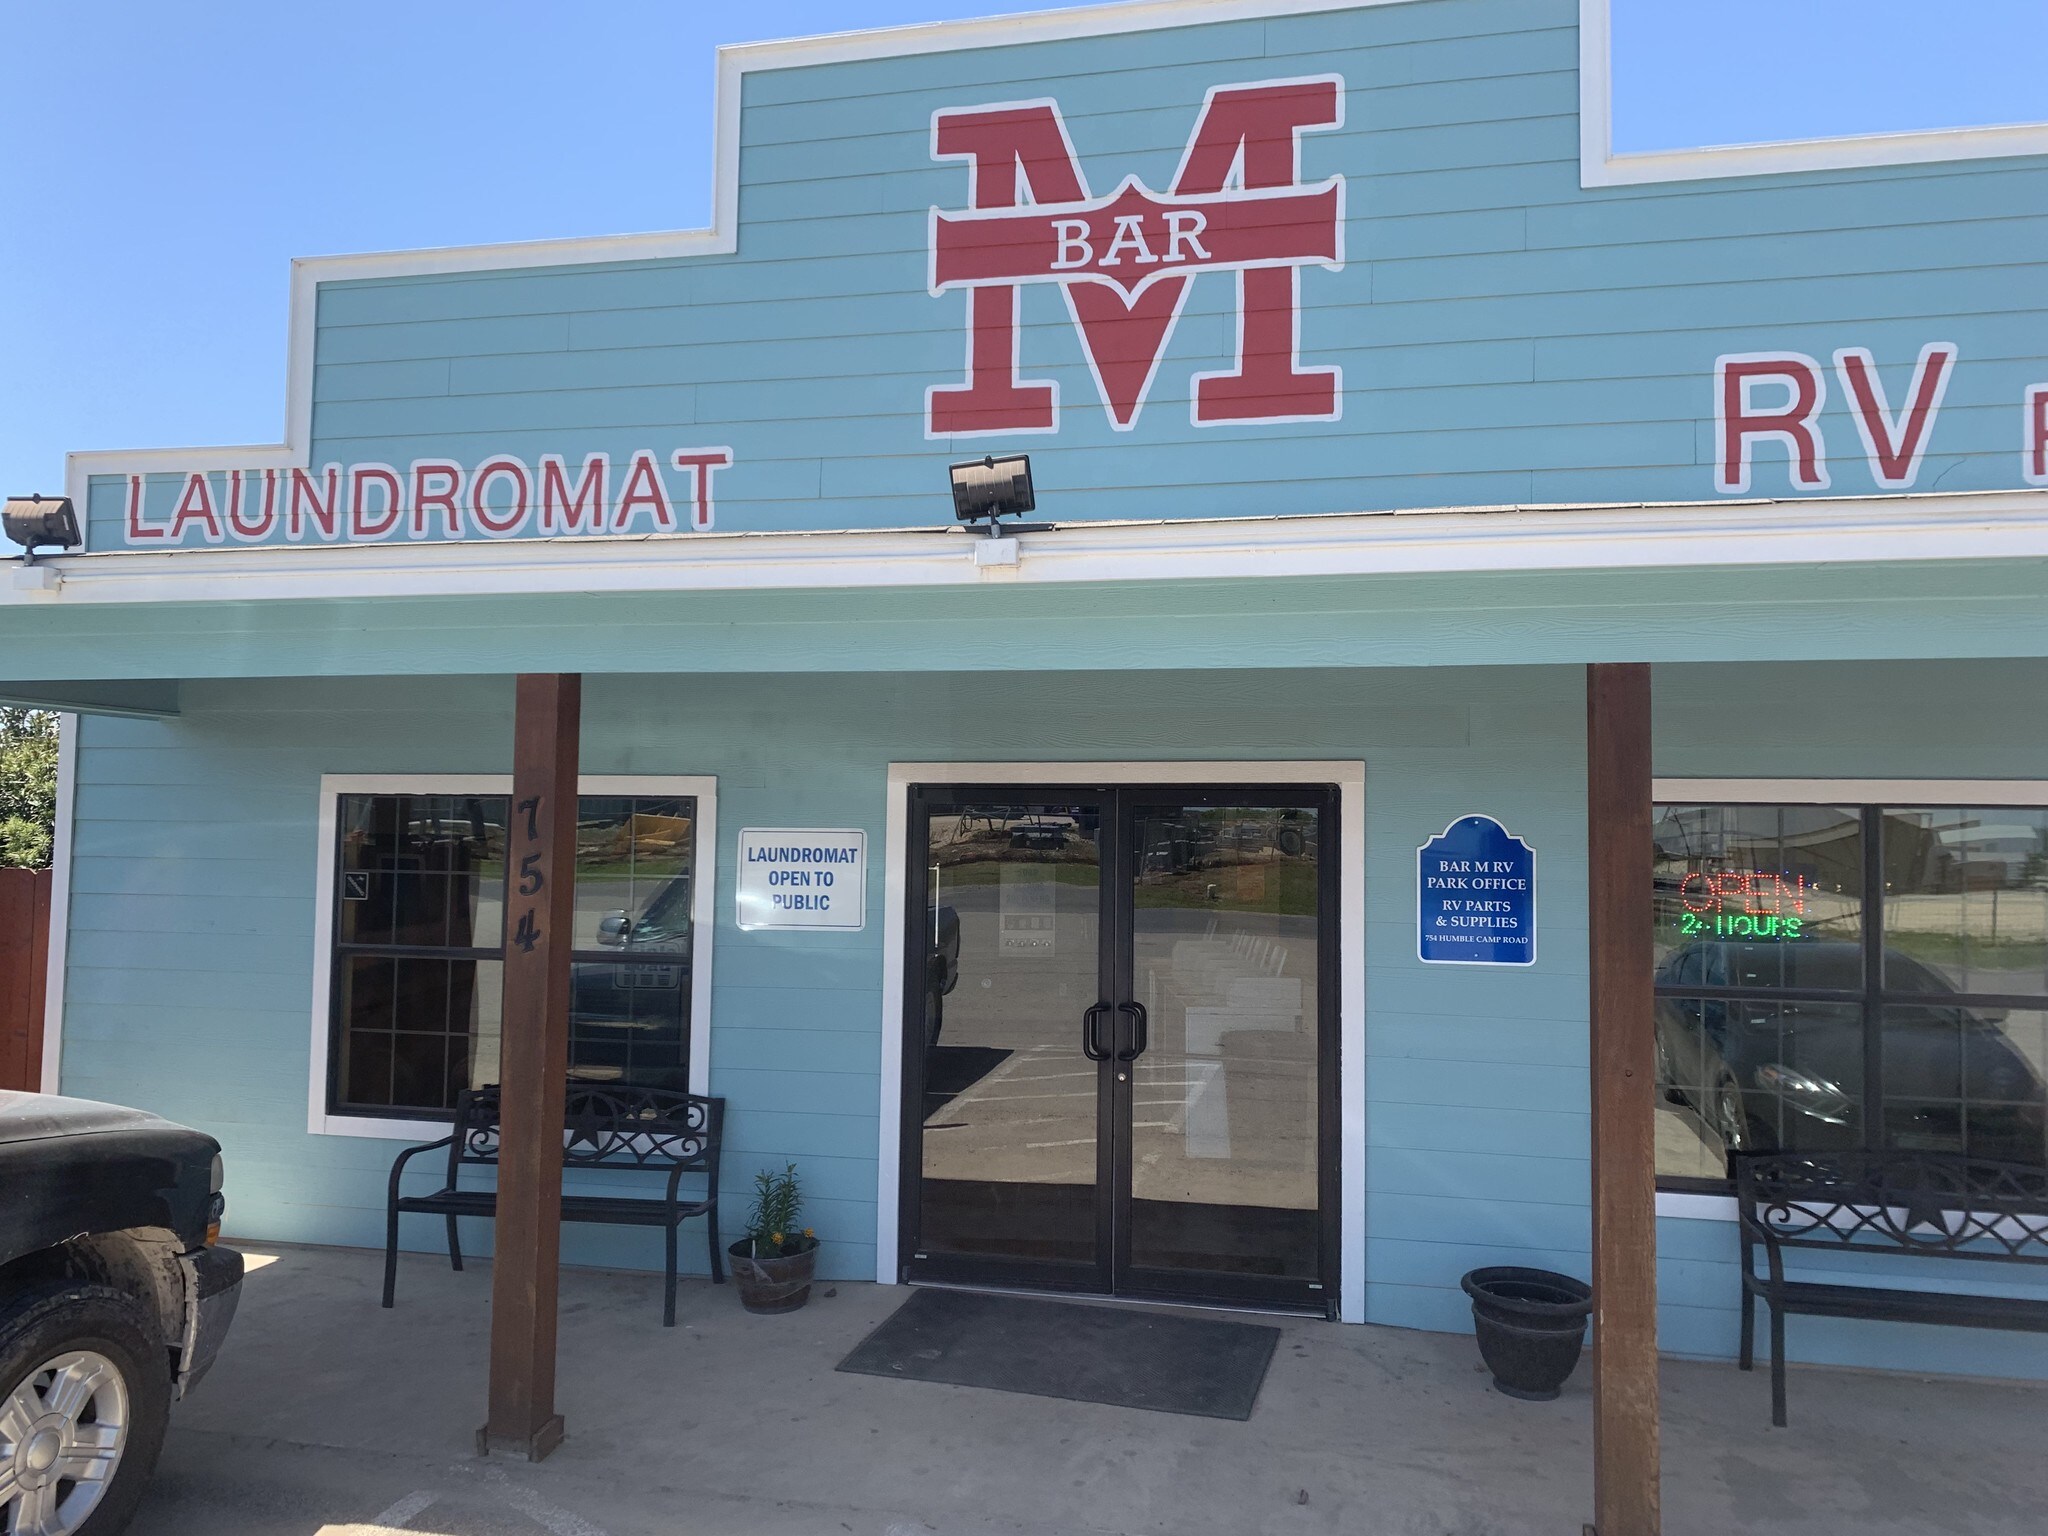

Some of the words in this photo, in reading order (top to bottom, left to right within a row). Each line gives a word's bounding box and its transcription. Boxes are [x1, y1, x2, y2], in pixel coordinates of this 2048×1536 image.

[1050, 210, 1211, 269] BAR
[1714, 341, 1959, 494] RV
[124, 446, 733, 545] LAUNDROMAT
[748, 846, 858, 863] LAUNDROMAT
[1439, 860, 1471, 873] BAR
[1474, 861, 1490, 873] M
[1492, 861, 1514, 873] RV
[768, 870, 810, 886] OPEN
[814, 871, 834, 887] TO
[1427, 877, 1469, 889] PARK
[1471, 877, 1527, 890] OFFICE
[1681, 872, 1805, 914] OPEN
[772, 894, 830, 910] PUBLIC
[1442, 899, 1462, 911] RV
[1465, 900, 1511, 913] PARTS
[1435, 915, 1448, 927] &
[1450, 915, 1518, 929] SUPPLIES
[1424, 934, 1438, 943] 754
[1439, 934, 1475, 943] HUMBLE
[1475, 935, 1502, 944] CAMP
[1502, 936, 1529, 944] ROAD
